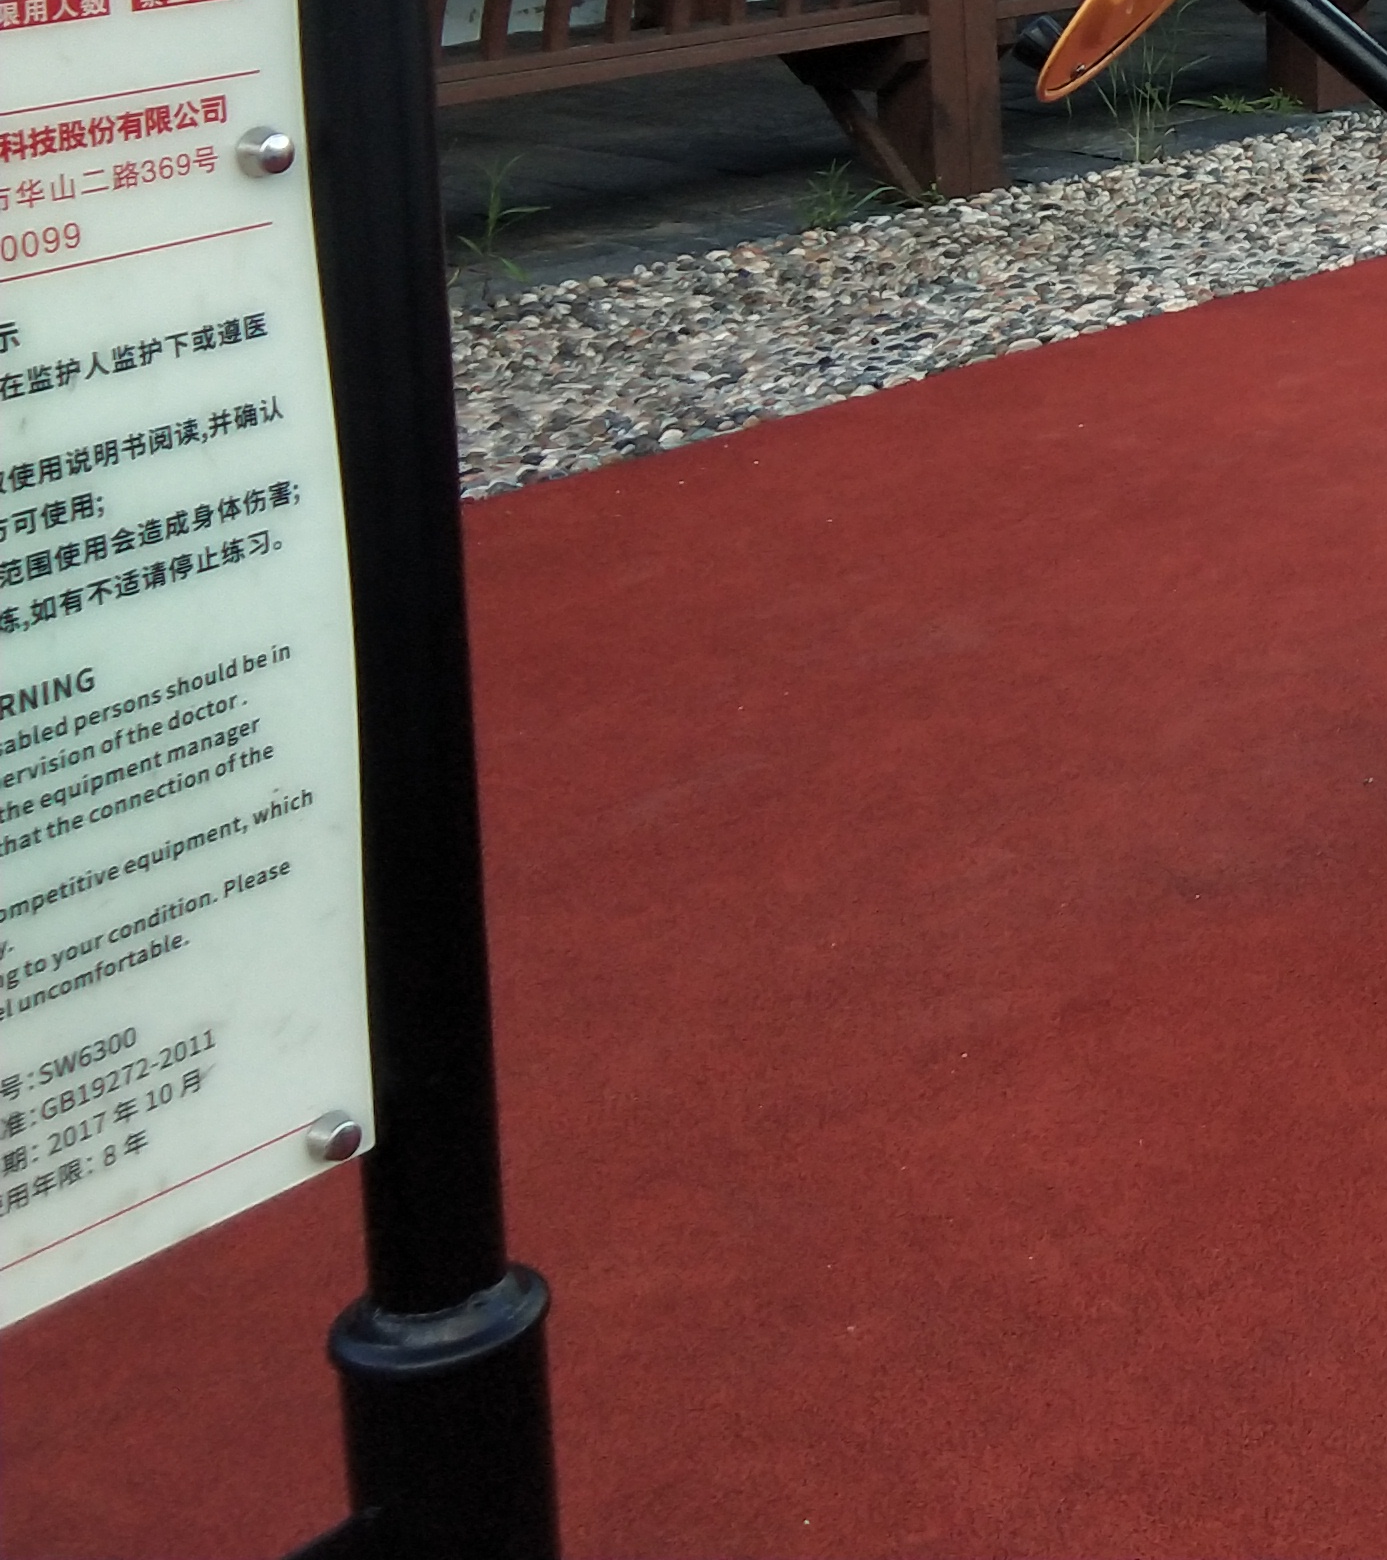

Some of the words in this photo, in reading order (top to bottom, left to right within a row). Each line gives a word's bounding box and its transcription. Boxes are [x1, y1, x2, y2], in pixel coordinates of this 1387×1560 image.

[0, 311, 268, 400] 在监护人监护下或遵医
[74, 688, 162, 736] persons
[166, 658, 237, 701] should
[243, 652, 268, 674] be
[271, 643, 291, 664] in
[40, 750, 162, 808] equipment
[167, 717, 260, 764] manager
[101, 728, 124, 755] of
[126, 720, 163, 746] the
[47, 813, 84, 839] the
[89, 768, 210, 824] connection
[215, 755, 237, 778] of
[240, 743, 275, 768] the
[123, 816, 248, 873] equipment,
[252, 788, 314, 826] which
[24, 956, 47, 978] to
[51, 933, 104, 972] your
[107, 890, 218, 945] condition.
[223, 860, 291, 899] Please
[19, 932, 190, 1013] uncomfortable.
[47, 1111, 106, 1156] 2017
[113, 1097, 139, 1124] 年
[146, 1082, 173, 1112] 10
[180, 1067, 201, 1098] 月
[103, 1144, 117, 1167] 8
[124, 1129, 149, 1155] 年
